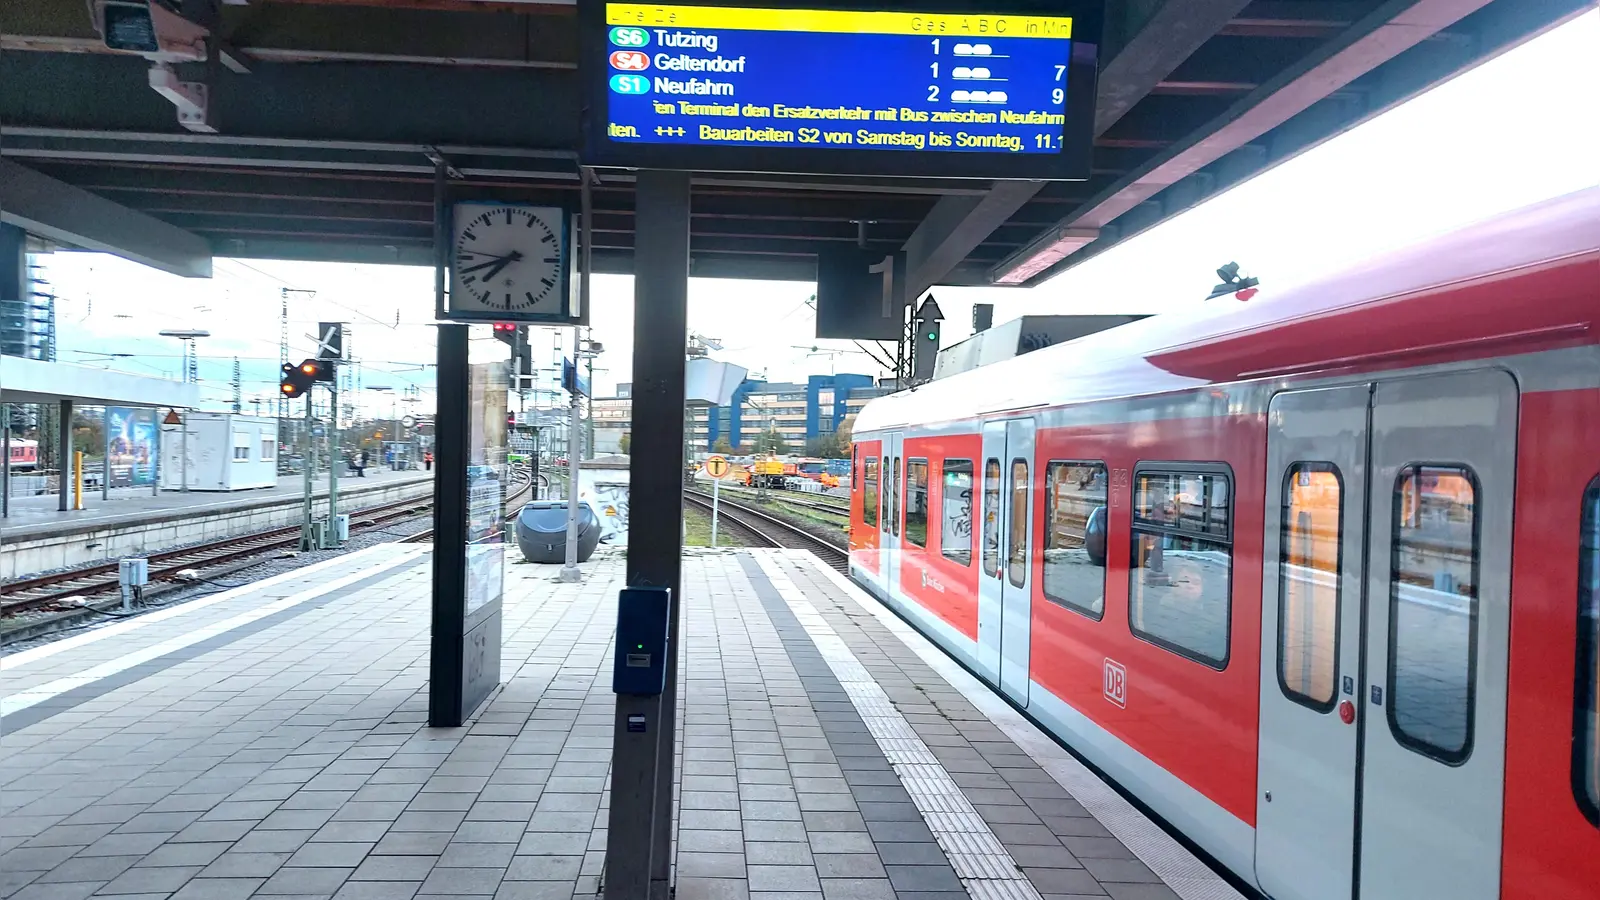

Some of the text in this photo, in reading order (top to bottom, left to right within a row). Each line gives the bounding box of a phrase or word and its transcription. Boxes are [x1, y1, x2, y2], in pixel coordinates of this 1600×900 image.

[979, 19, 989, 33] B
[995, 20, 1007, 33] C
[1026, 20, 1038, 33] in
[616, 28, 643, 45] S6
[653, 29, 718, 52] Tutzing
[931, 38, 940, 55] 1
[616, 52, 643, 69] S4
[654, 53, 746, 73] Geltendorf
[930, 62, 939, 78] 1
[1054, 65, 1066, 81] 7
[618, 76, 641, 92] S1
[654, 76, 734, 96] Neufahrn
[927, 85, 940, 102] 2
[1051, 88, 1064, 105] 9
[677, 101, 739, 116] Terminal
[742, 103, 770, 118] den
[773, 103, 872, 120] Ersatzverkehr
[874, 107, 898, 121] mit
[900, 108, 929, 122] Bus
[931, 109, 997, 123] zwischen
[699, 124, 794, 142] Bauarbeiten
[797, 127, 820, 143] S2
[823, 131, 853, 144] von
[856, 129, 925, 150] Samstag
[929, 131, 952, 146] bis
[955, 131, 1025, 151] Sonntag,
[868, 255, 894, 318] 1
[1106, 664, 1124, 701] DB
